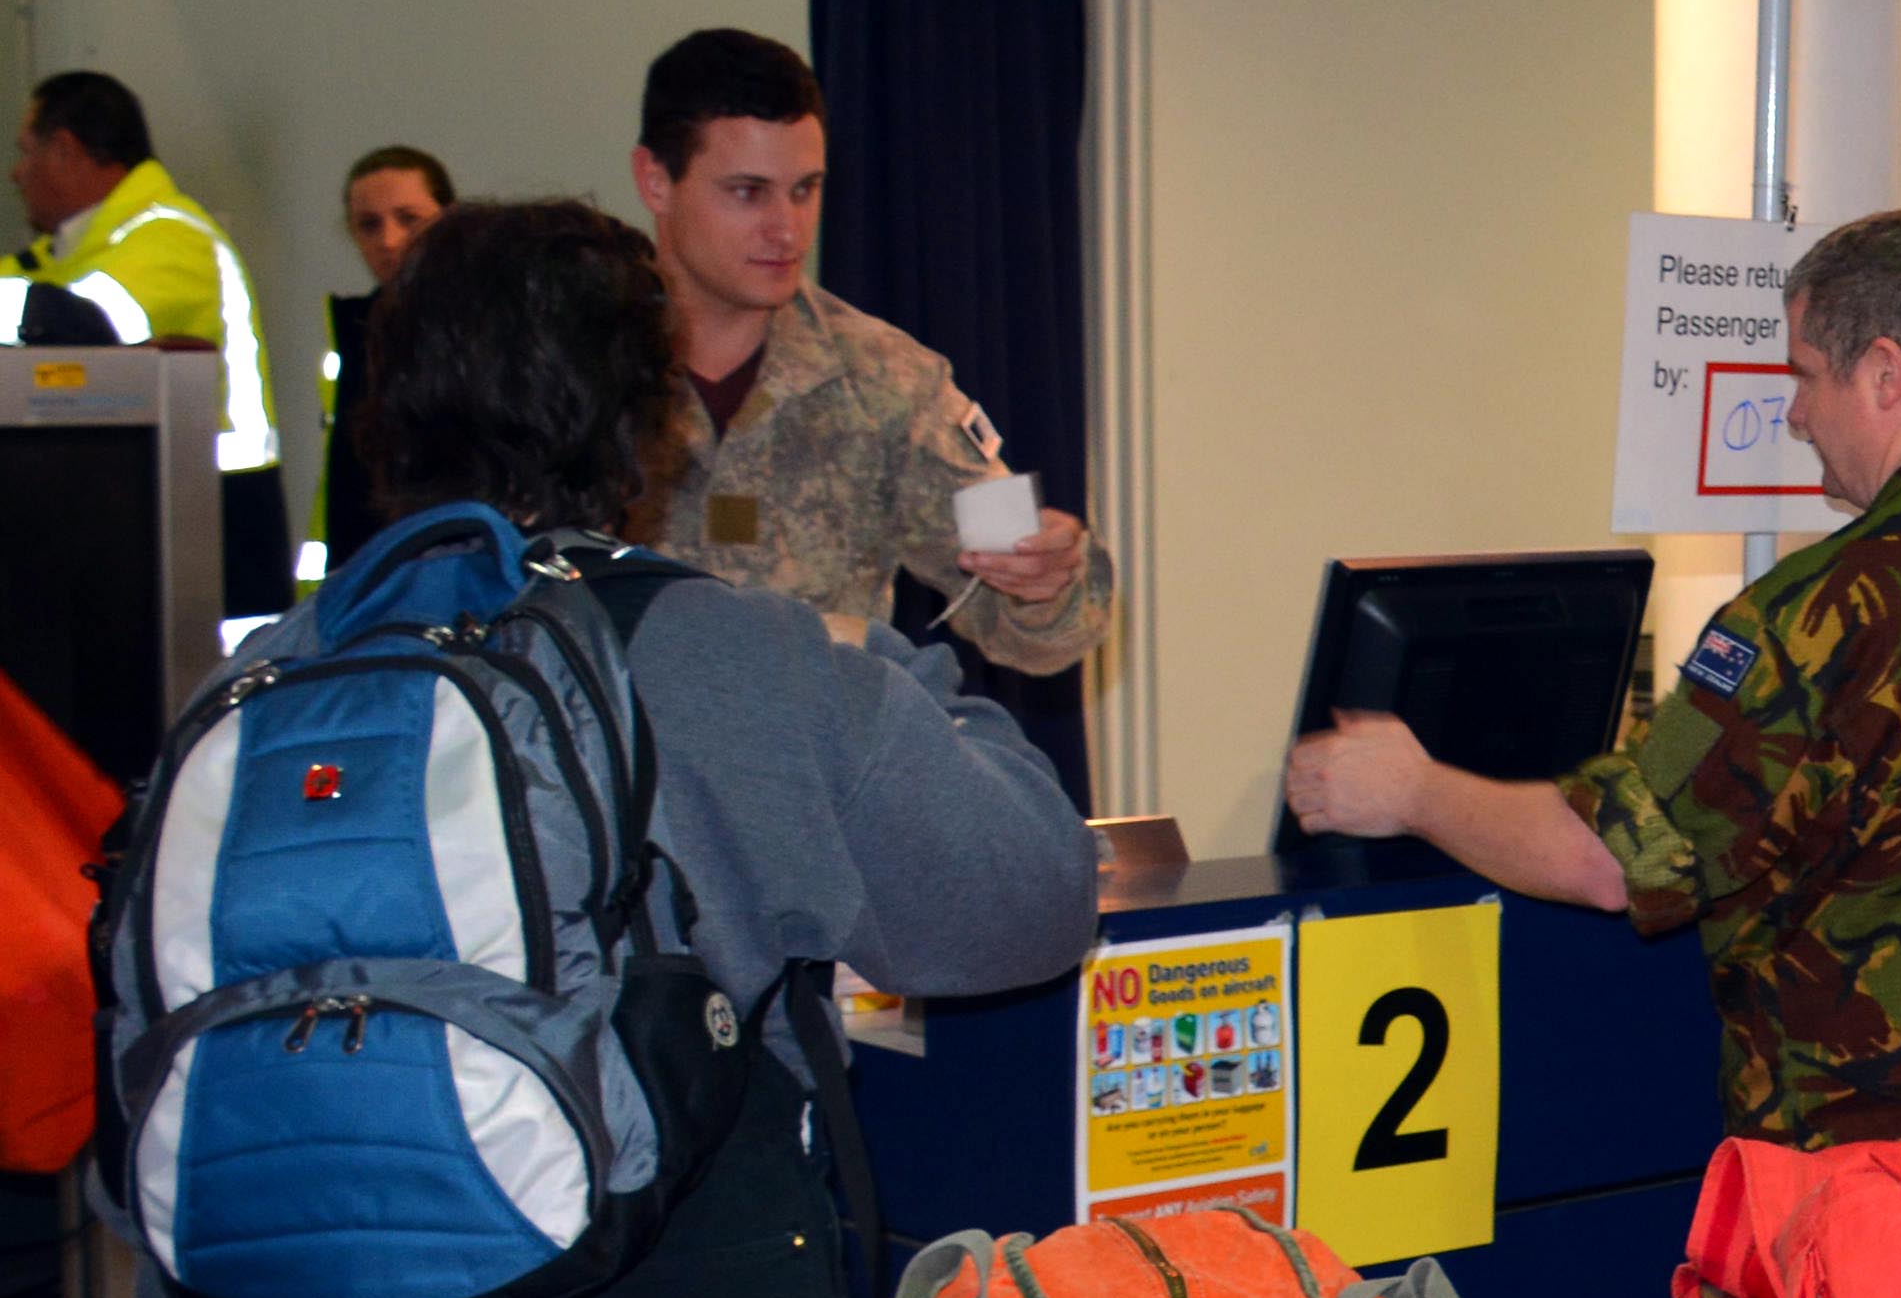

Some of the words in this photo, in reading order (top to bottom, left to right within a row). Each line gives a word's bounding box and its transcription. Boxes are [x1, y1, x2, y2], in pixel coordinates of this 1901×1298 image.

[1659, 254, 1739, 287] Please
[1746, 265, 1788, 289] retu
[1657, 306, 1781, 345] Passenger
[1653, 360, 1688, 395] by:
[1722, 396, 1786, 451] 07
[1092, 966, 1142, 1012] NO
[1149, 957, 1250, 985] Dangerous
[1148, 985, 1196, 1006] Goods
[1199, 985, 1218, 999] on
[1222, 974, 1277, 996] aircraft
[1352, 986, 1450, 1172] 2
